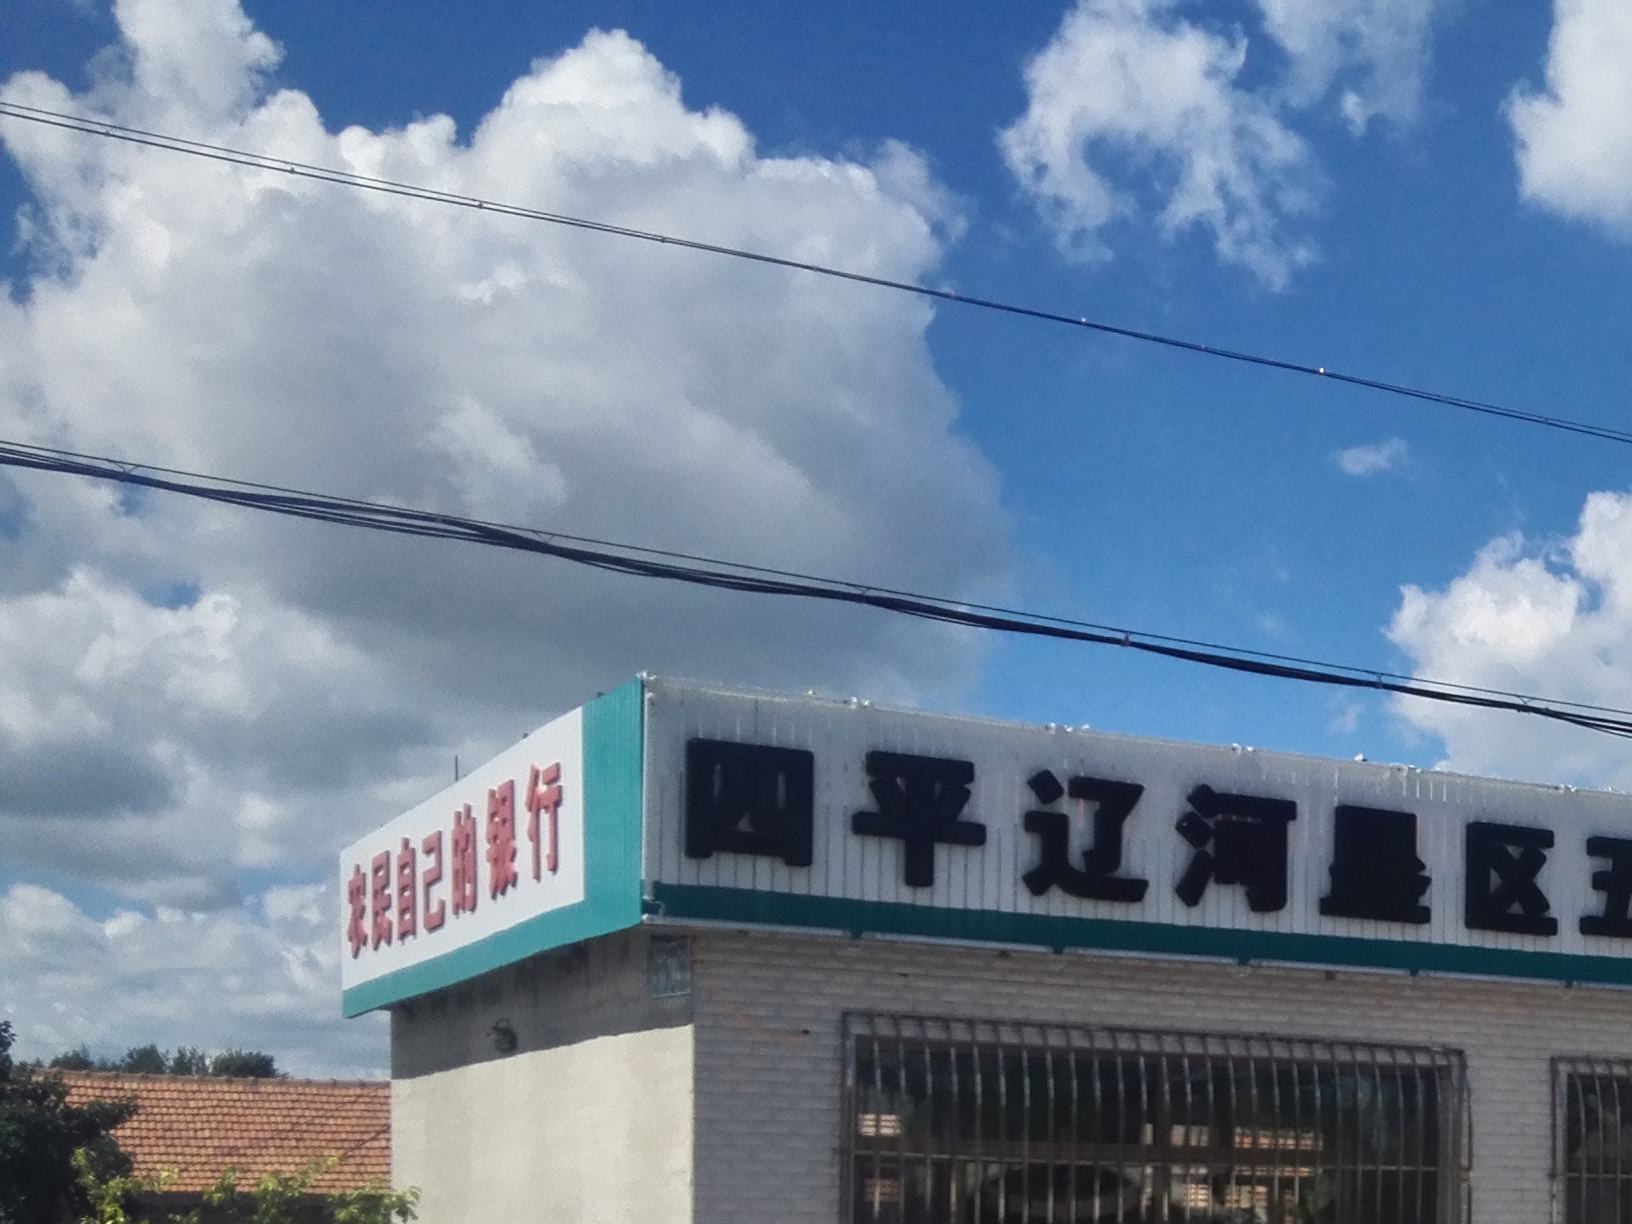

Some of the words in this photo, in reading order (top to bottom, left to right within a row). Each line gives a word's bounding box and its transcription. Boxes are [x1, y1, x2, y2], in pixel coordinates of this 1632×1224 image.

[347, 761, 563, 959] 农民自己的银行
